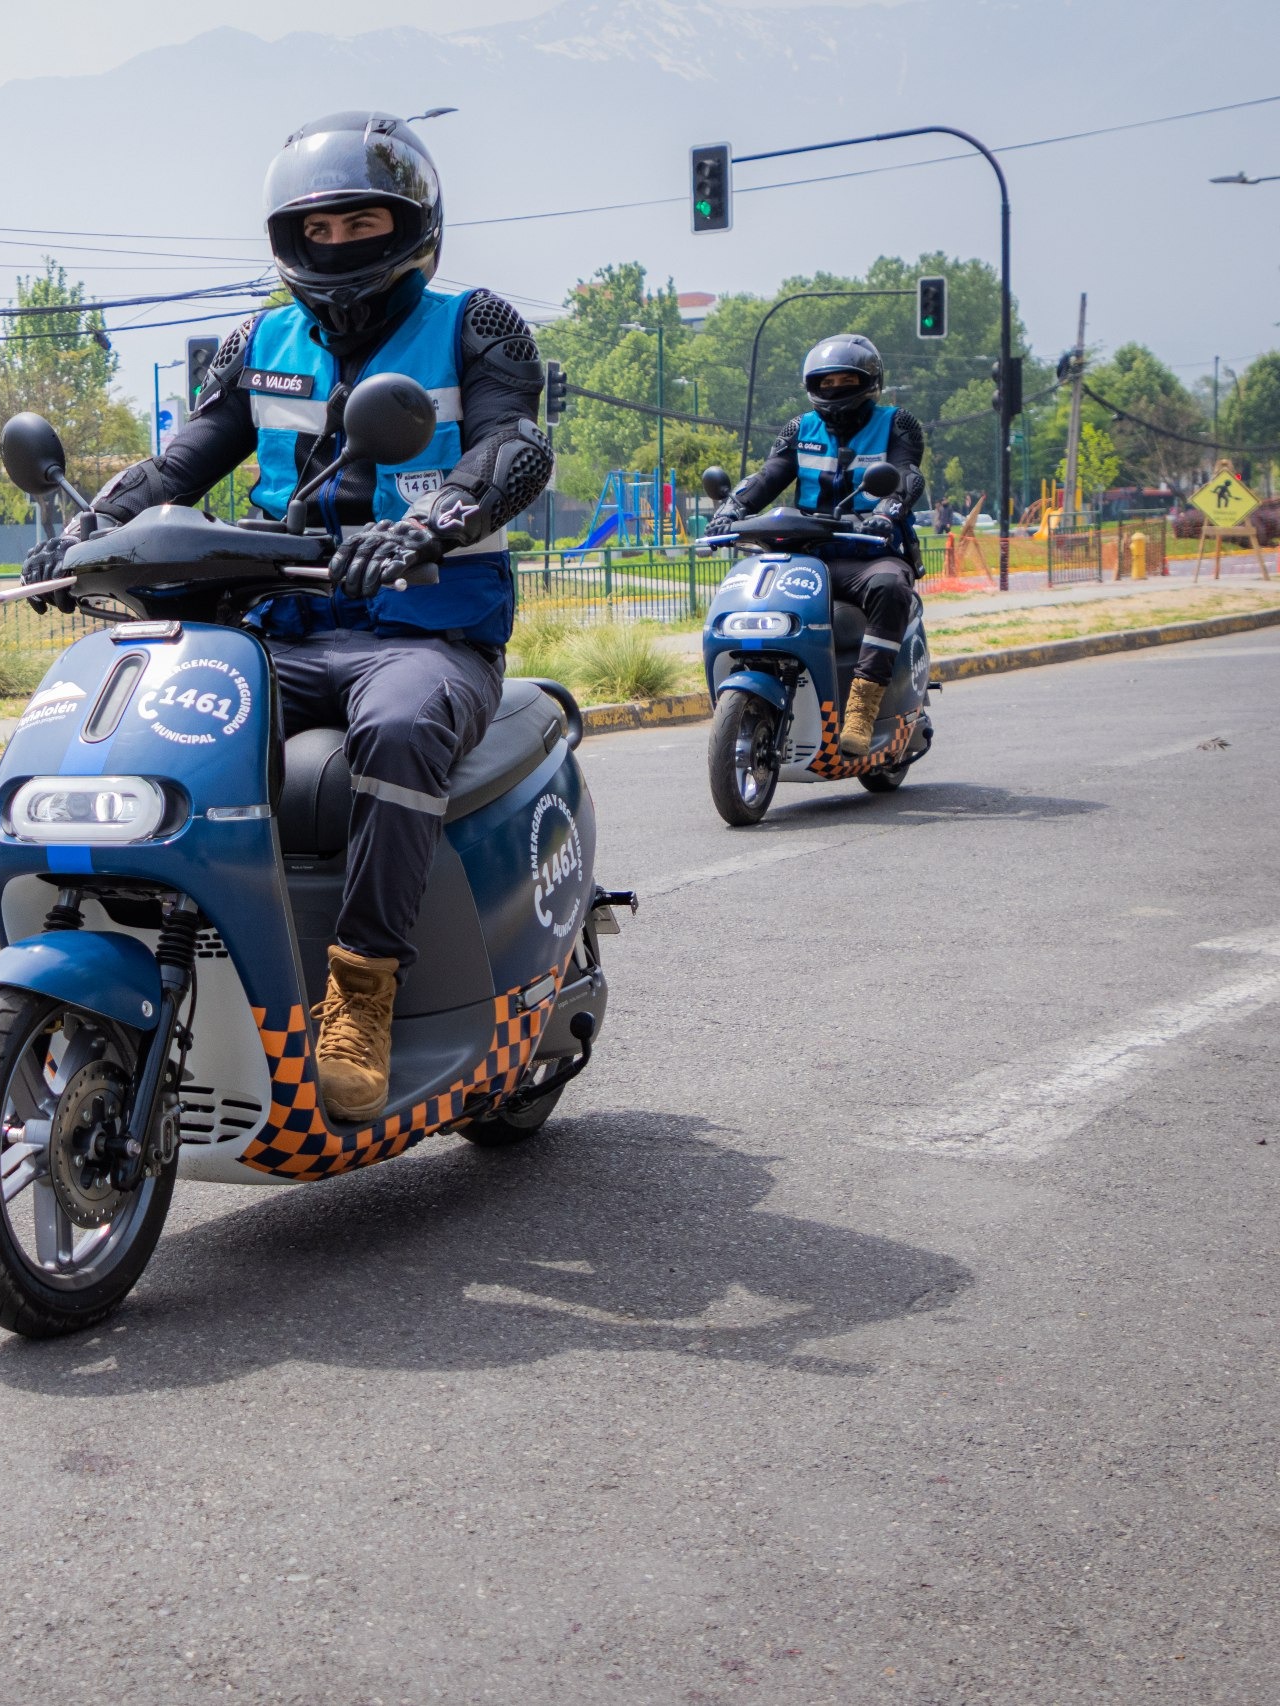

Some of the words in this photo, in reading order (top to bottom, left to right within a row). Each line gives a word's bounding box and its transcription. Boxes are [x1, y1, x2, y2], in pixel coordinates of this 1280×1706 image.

[251, 373, 262, 386] G.
[266, 374, 302, 391] VALDÉS
[404, 479, 438, 493] 1461
[785, 576, 816, 590] 1461
[229, 668, 240, 677] Y
[158, 685, 232, 721] 1461
[223, 676, 252, 735] SEGURIDAD
[151, 721, 217, 744] MUNICIPAL
[530, 793, 552, 881] EMERGENCIA
[551, 793, 558, 807] Y
[558, 797, 583, 882] SEGURIDAD
[542, 837, 578, 897] 1461
